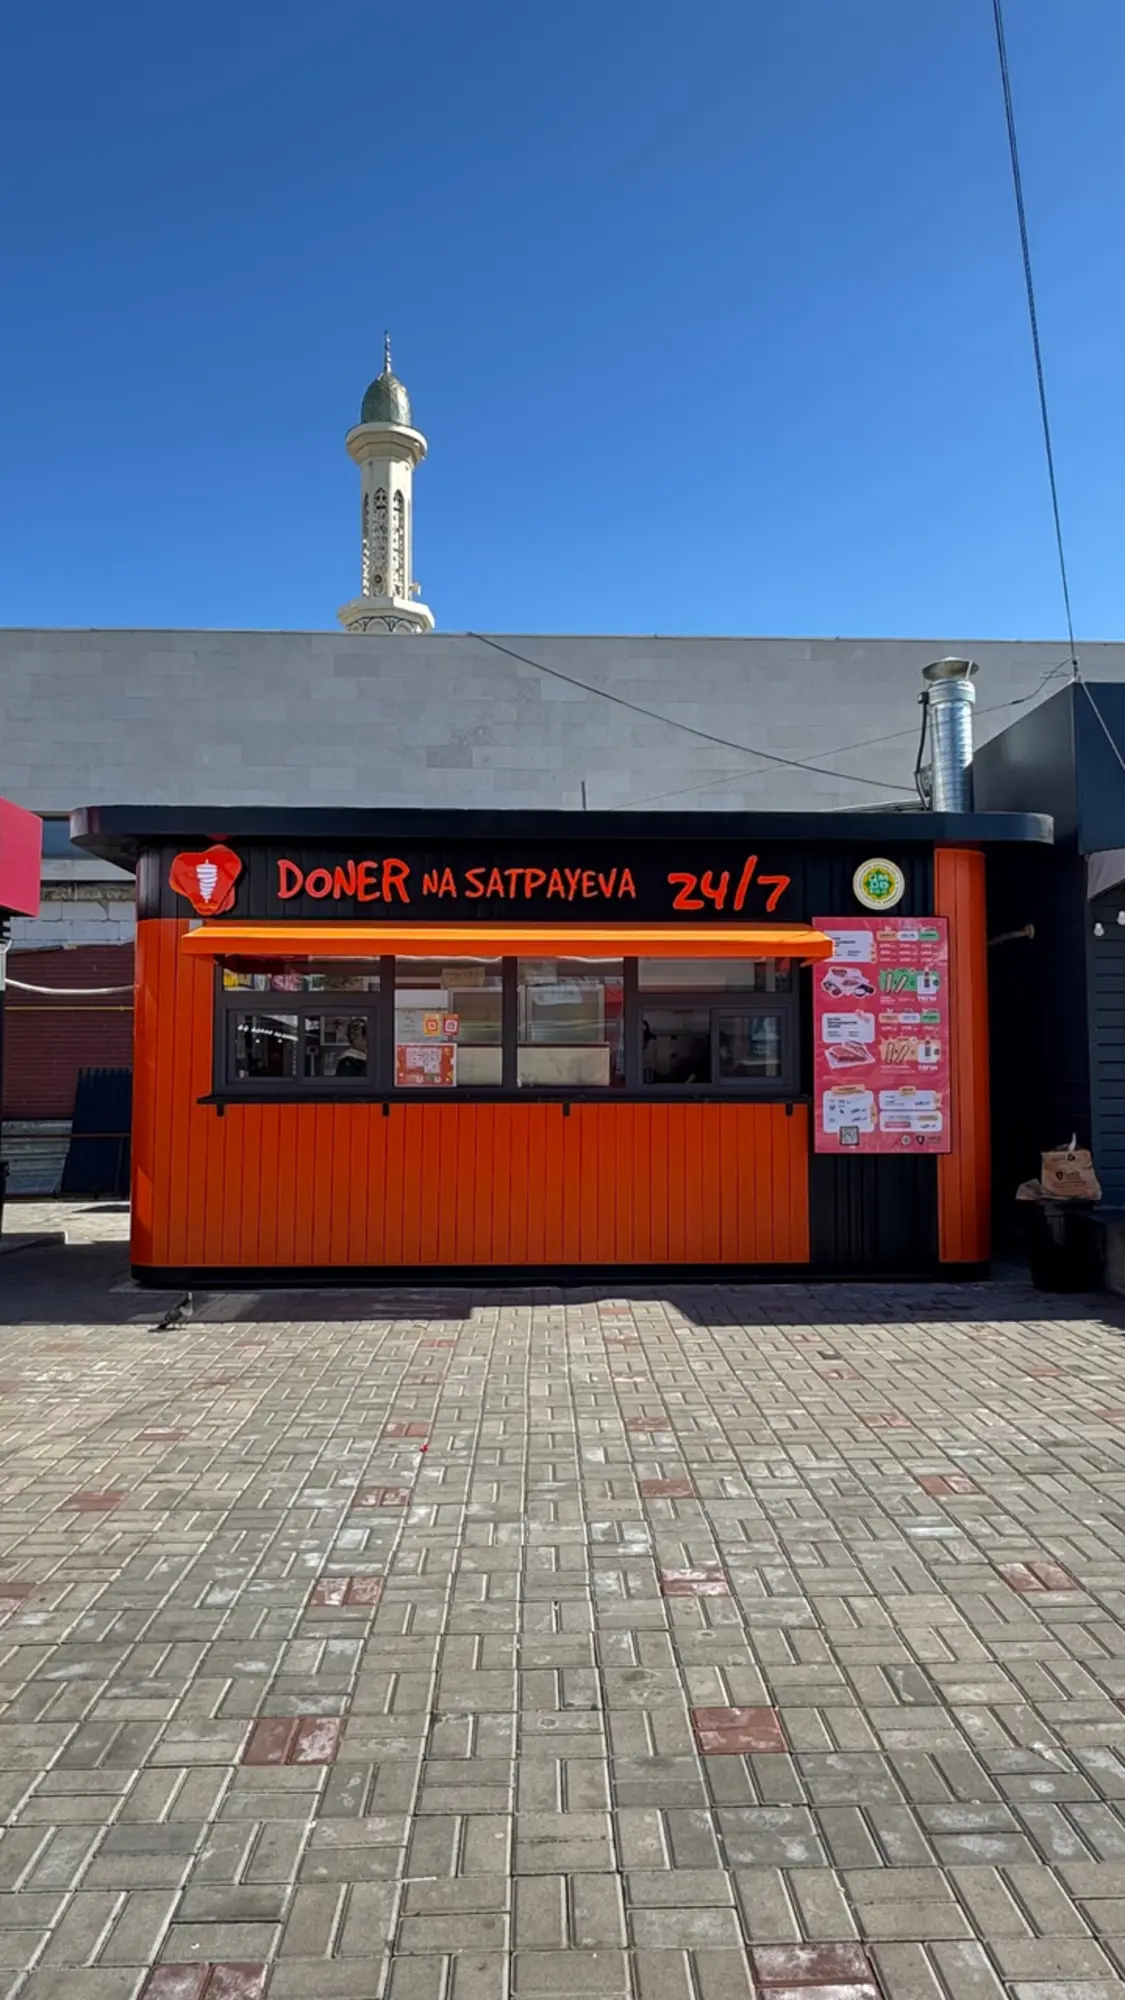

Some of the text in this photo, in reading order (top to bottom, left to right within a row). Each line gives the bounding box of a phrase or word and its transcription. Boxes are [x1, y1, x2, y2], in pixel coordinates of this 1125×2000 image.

[277, 854, 791, 912] DONER NA SATPAYEVA 24/7
